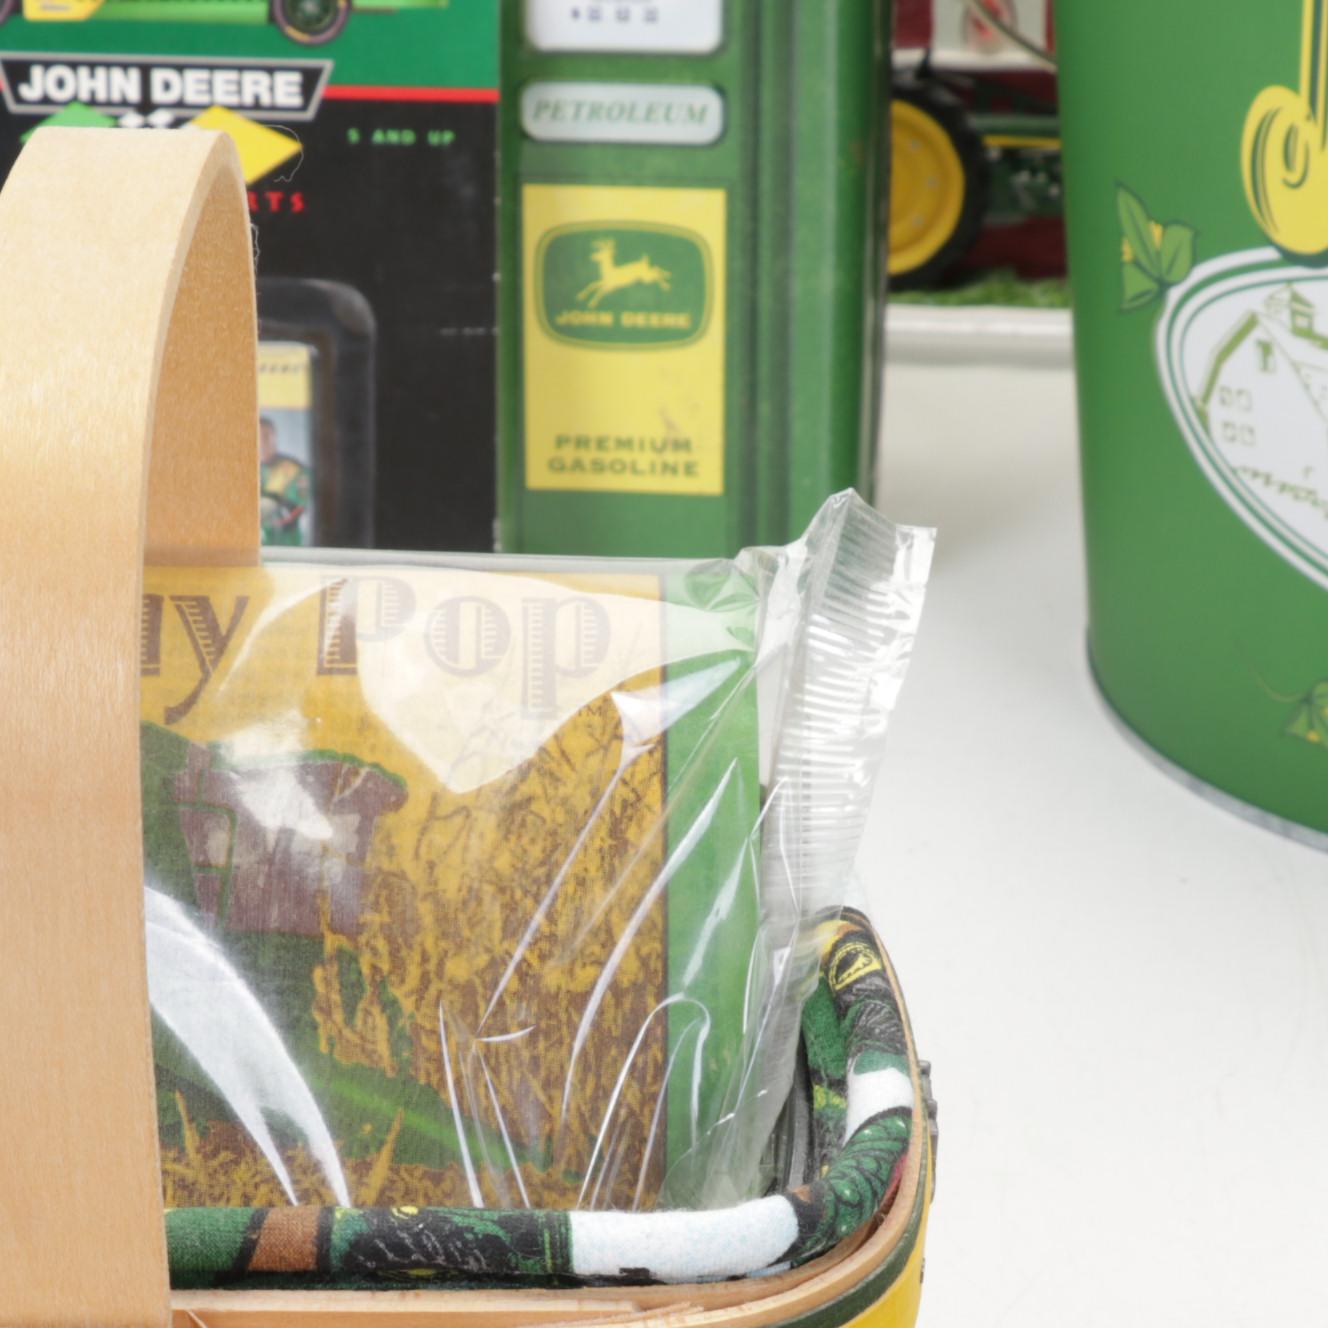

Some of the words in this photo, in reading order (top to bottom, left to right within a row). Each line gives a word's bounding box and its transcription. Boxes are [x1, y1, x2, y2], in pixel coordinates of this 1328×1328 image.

[18, 64, 141, 102] JOHN
[150, 67, 304, 107] DEERE
[532, 99, 709, 125] PETROLEUM
[371, 129, 416, 145] AND
[427, 130, 456, 146] UP
[555, 311, 614, 328] JOHN
[622, 311, 692, 329] DEERE
[554, 434, 693, 453] PREMIUM
[547, 457, 700, 478] GASOLINE
[317, 574, 611, 720] Pop
